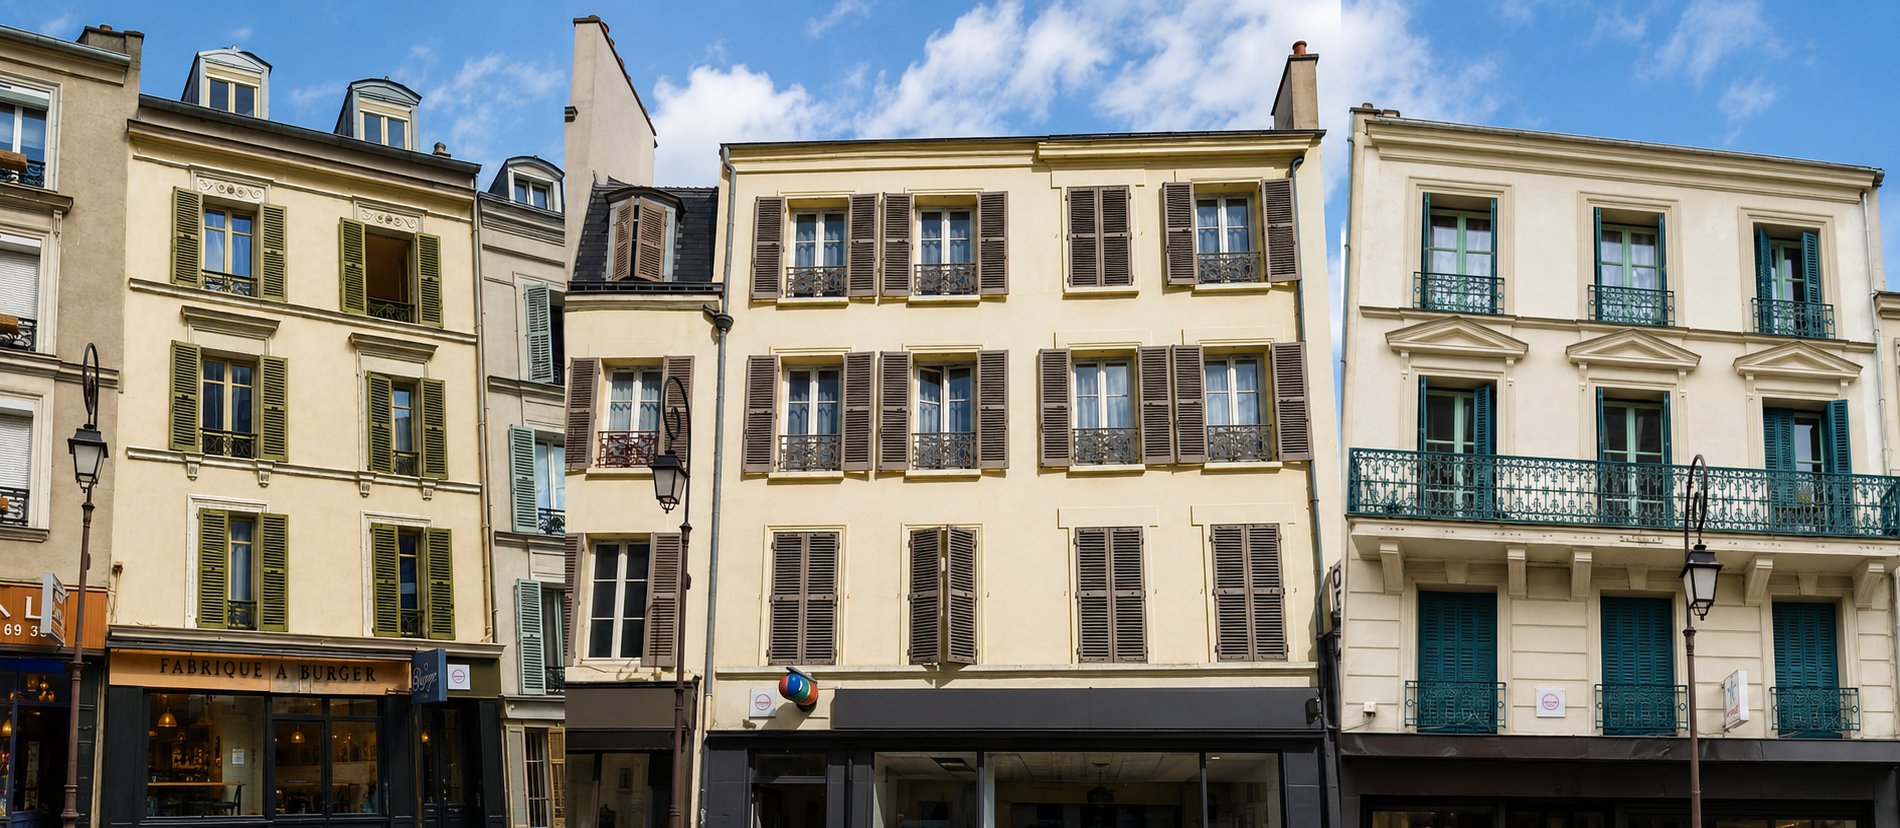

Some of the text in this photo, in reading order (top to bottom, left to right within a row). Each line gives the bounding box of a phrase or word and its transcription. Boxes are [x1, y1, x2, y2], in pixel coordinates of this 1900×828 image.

[4, 623, 22, 636] 69
[159, 657, 263, 679] FABRIQUE
[300, 664, 376, 682] BURGER
